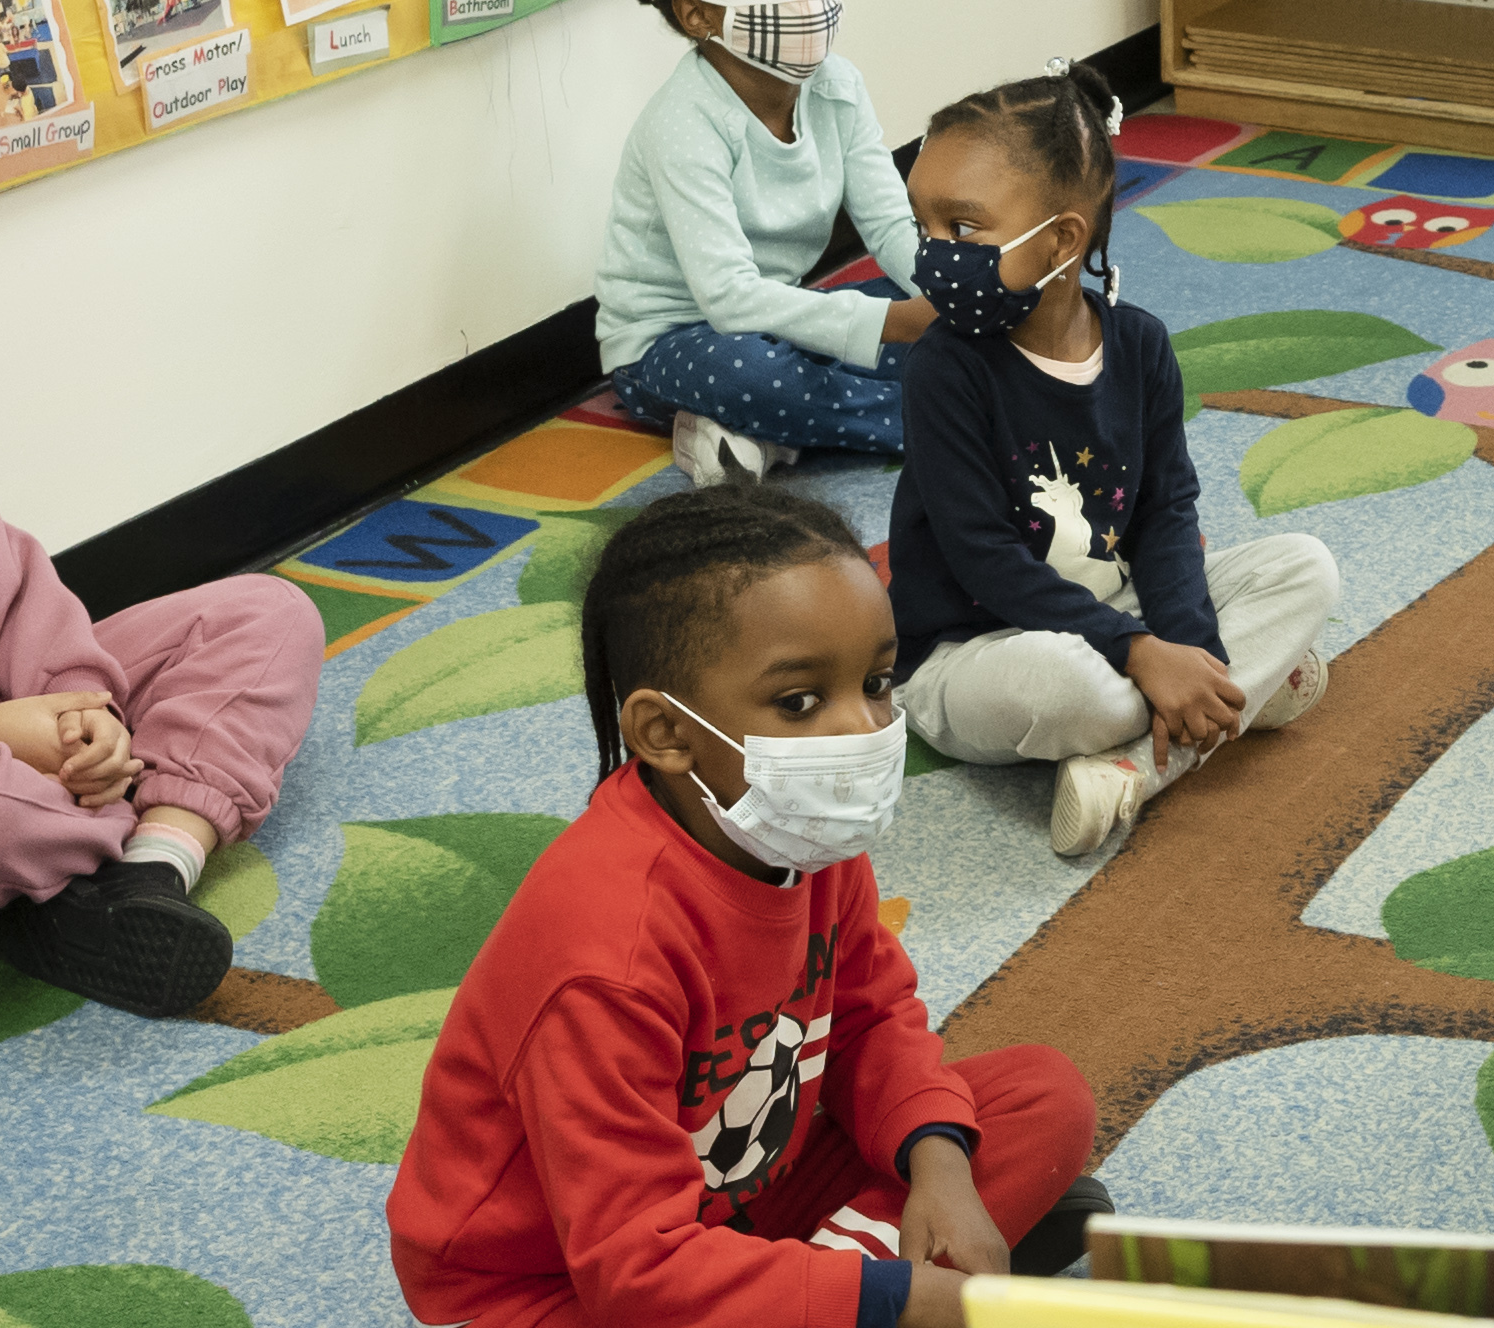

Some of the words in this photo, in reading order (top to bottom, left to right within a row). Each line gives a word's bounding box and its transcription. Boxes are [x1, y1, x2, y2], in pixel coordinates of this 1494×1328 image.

[329, 27, 372, 51] Lunch
[145, 59, 186, 82] Gross
[193, 34, 244, 65] Motor/
[153, 86, 212, 119] Outdoor
[217, 74, 247, 96] Play
[46, 117, 91, 145] Group
[1248, 144, 1326, 170] A
